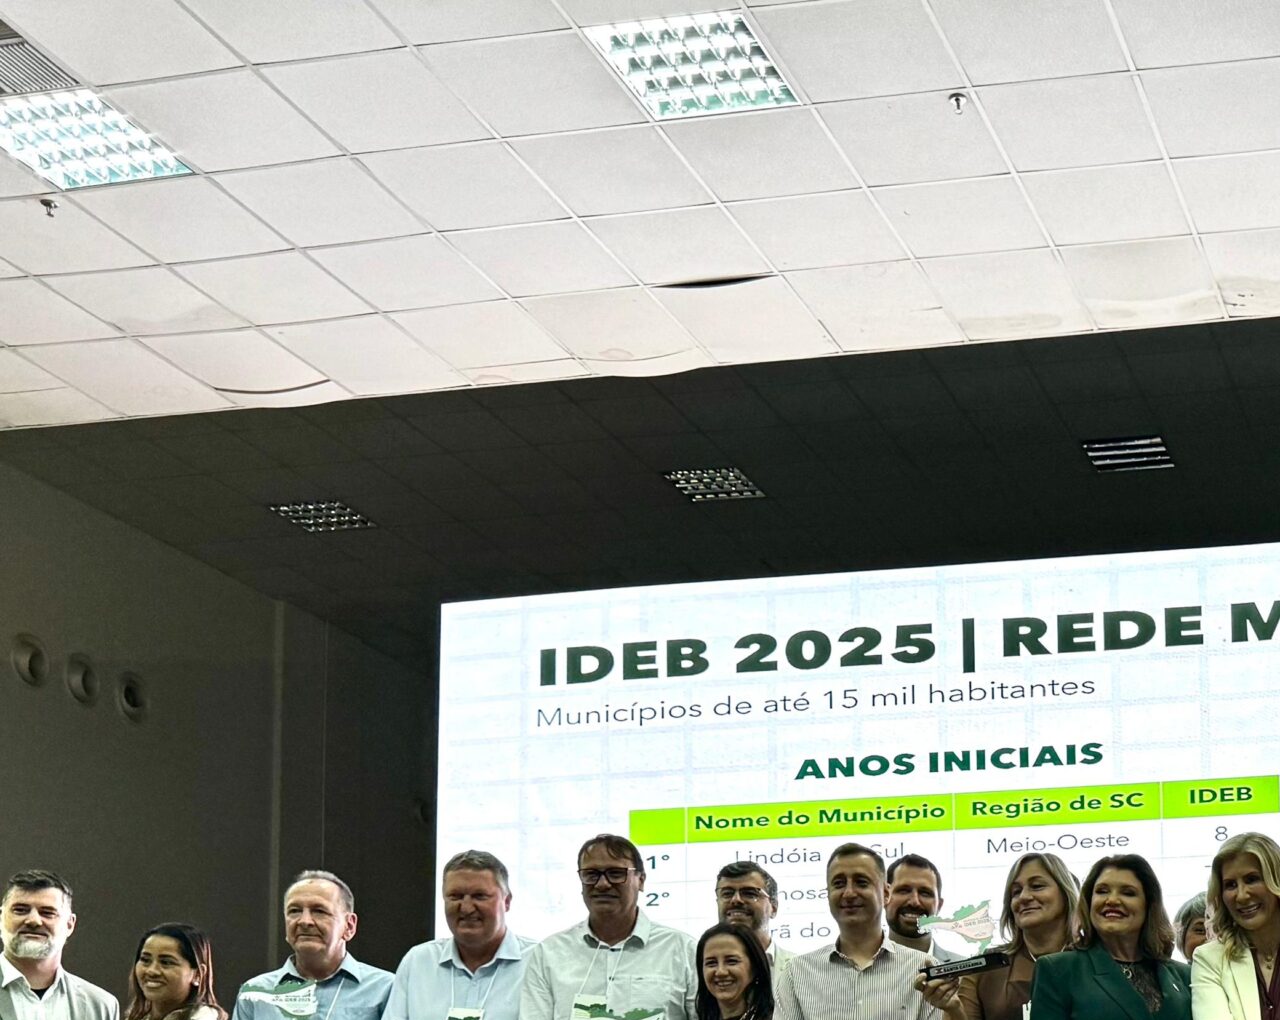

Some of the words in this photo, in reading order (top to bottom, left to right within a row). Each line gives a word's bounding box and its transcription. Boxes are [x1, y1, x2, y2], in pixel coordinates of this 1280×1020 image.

[540, 638, 709, 686] IDEB
[734, 623, 936, 673] 2025
[1003, 607, 1203, 657] REDE
[537, 701, 702, 727] Municípios
[713, 696, 752, 716] de
[763, 692, 810, 713] até
[823, 689, 858, 709] 15
[872, 685, 915, 706] mil
[930, 680, 1095, 703] habitantes
[794, 753, 915, 780] ANOS
[928, 742, 1103, 773] INICIAIS
[972, 798, 1061, 818] Região
[1070, 795, 1102, 811] de
[1110, 793, 1145, 808] SC
[1190, 787, 1253, 805] IDEB
[695, 816, 770, 830] Nome
[778, 811, 810, 826] do
[819, 804, 945, 824] Município
[987, 833, 1130, 854] Meio-Oeste
[1215, 826, 1228, 841] 8
[800, 922, 831, 938] do
